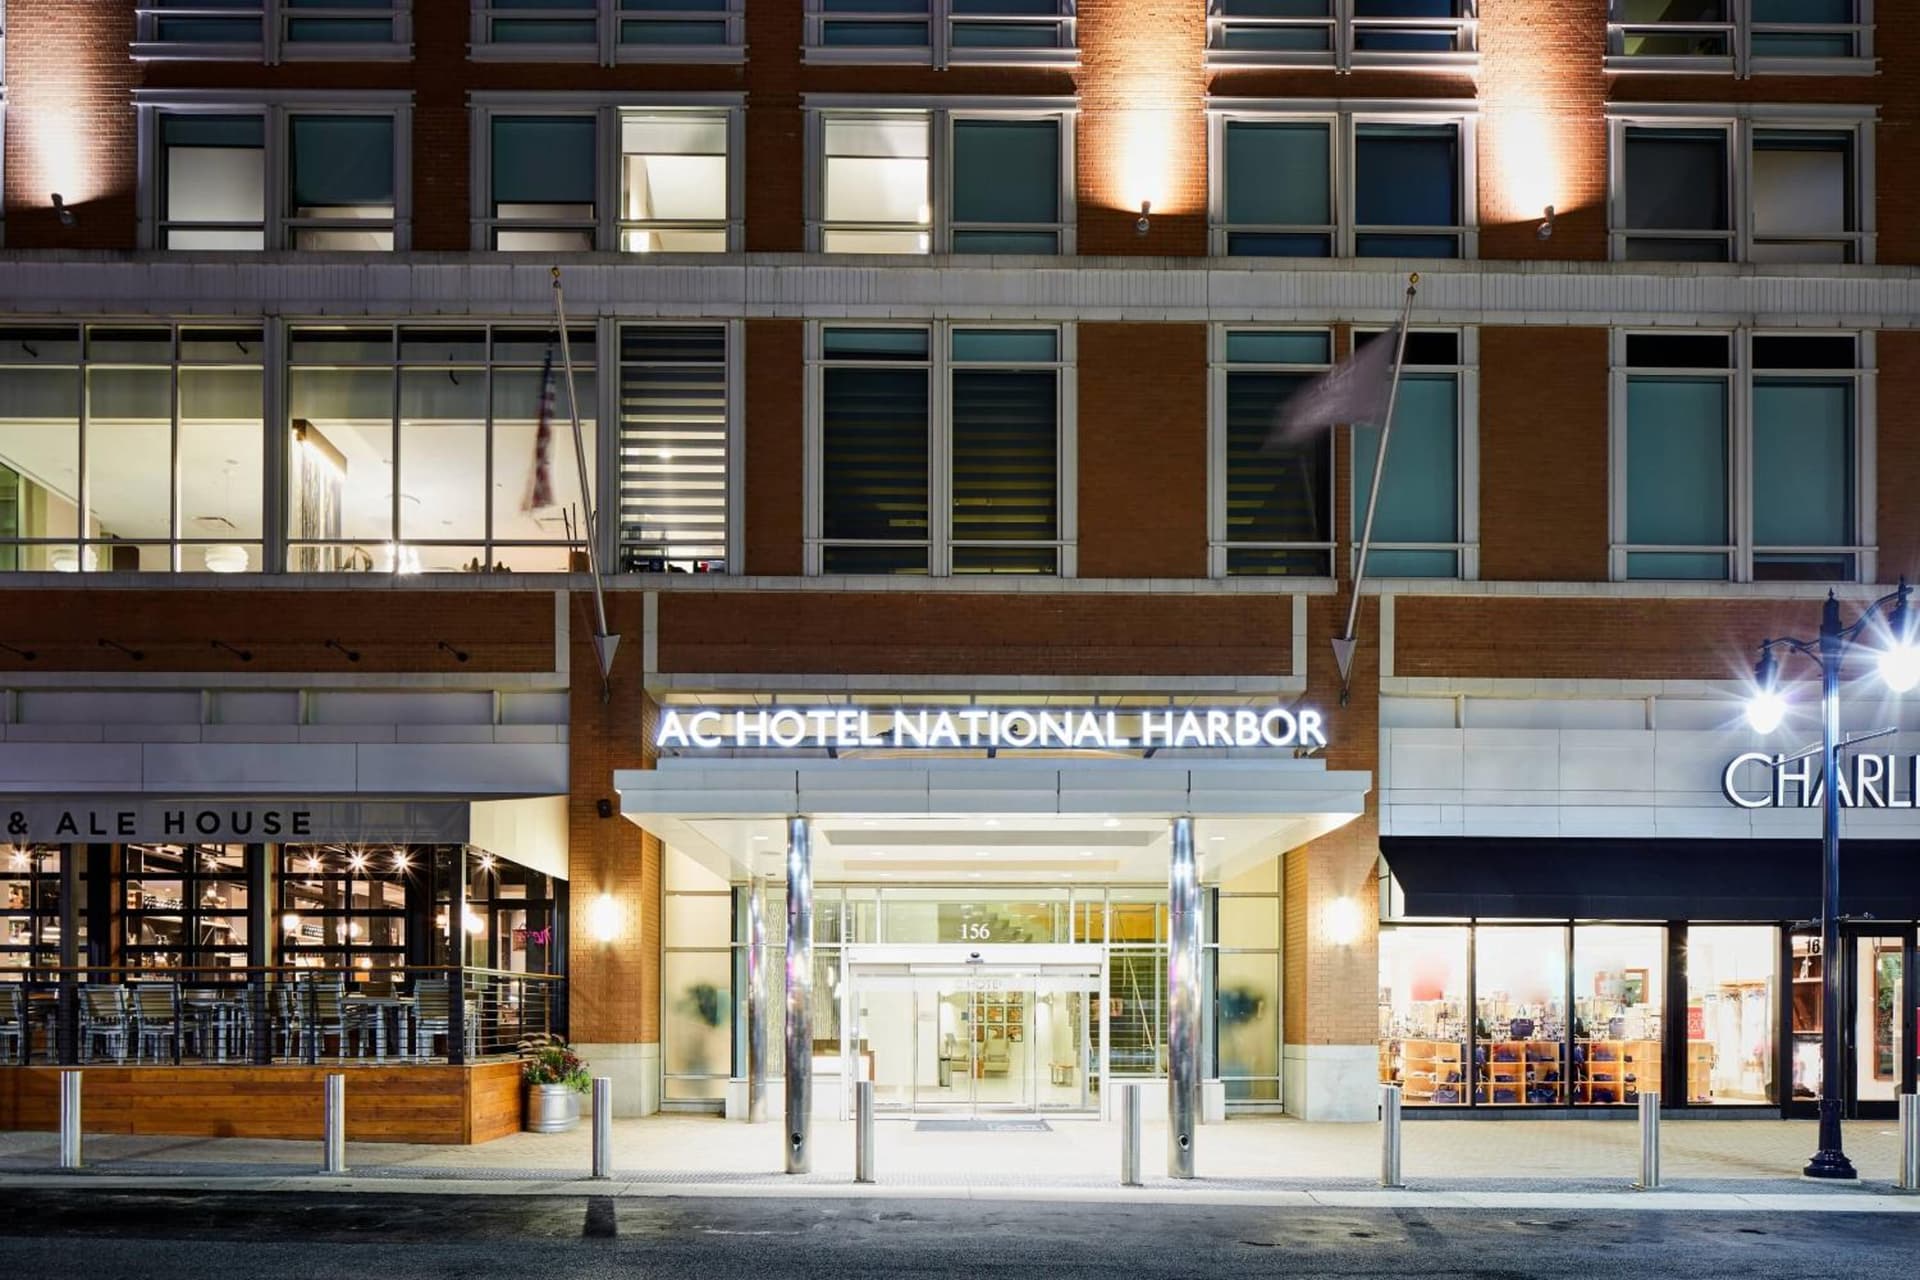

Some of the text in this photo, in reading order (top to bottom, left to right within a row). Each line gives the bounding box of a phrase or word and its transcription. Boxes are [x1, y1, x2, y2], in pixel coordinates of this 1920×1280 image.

[656, 708, 1328, 747] AC HOTEL NATIONAL HARBOR
[7, 811, 312, 836] & ALE HOUSE
[961, 923, 991, 940] 156
